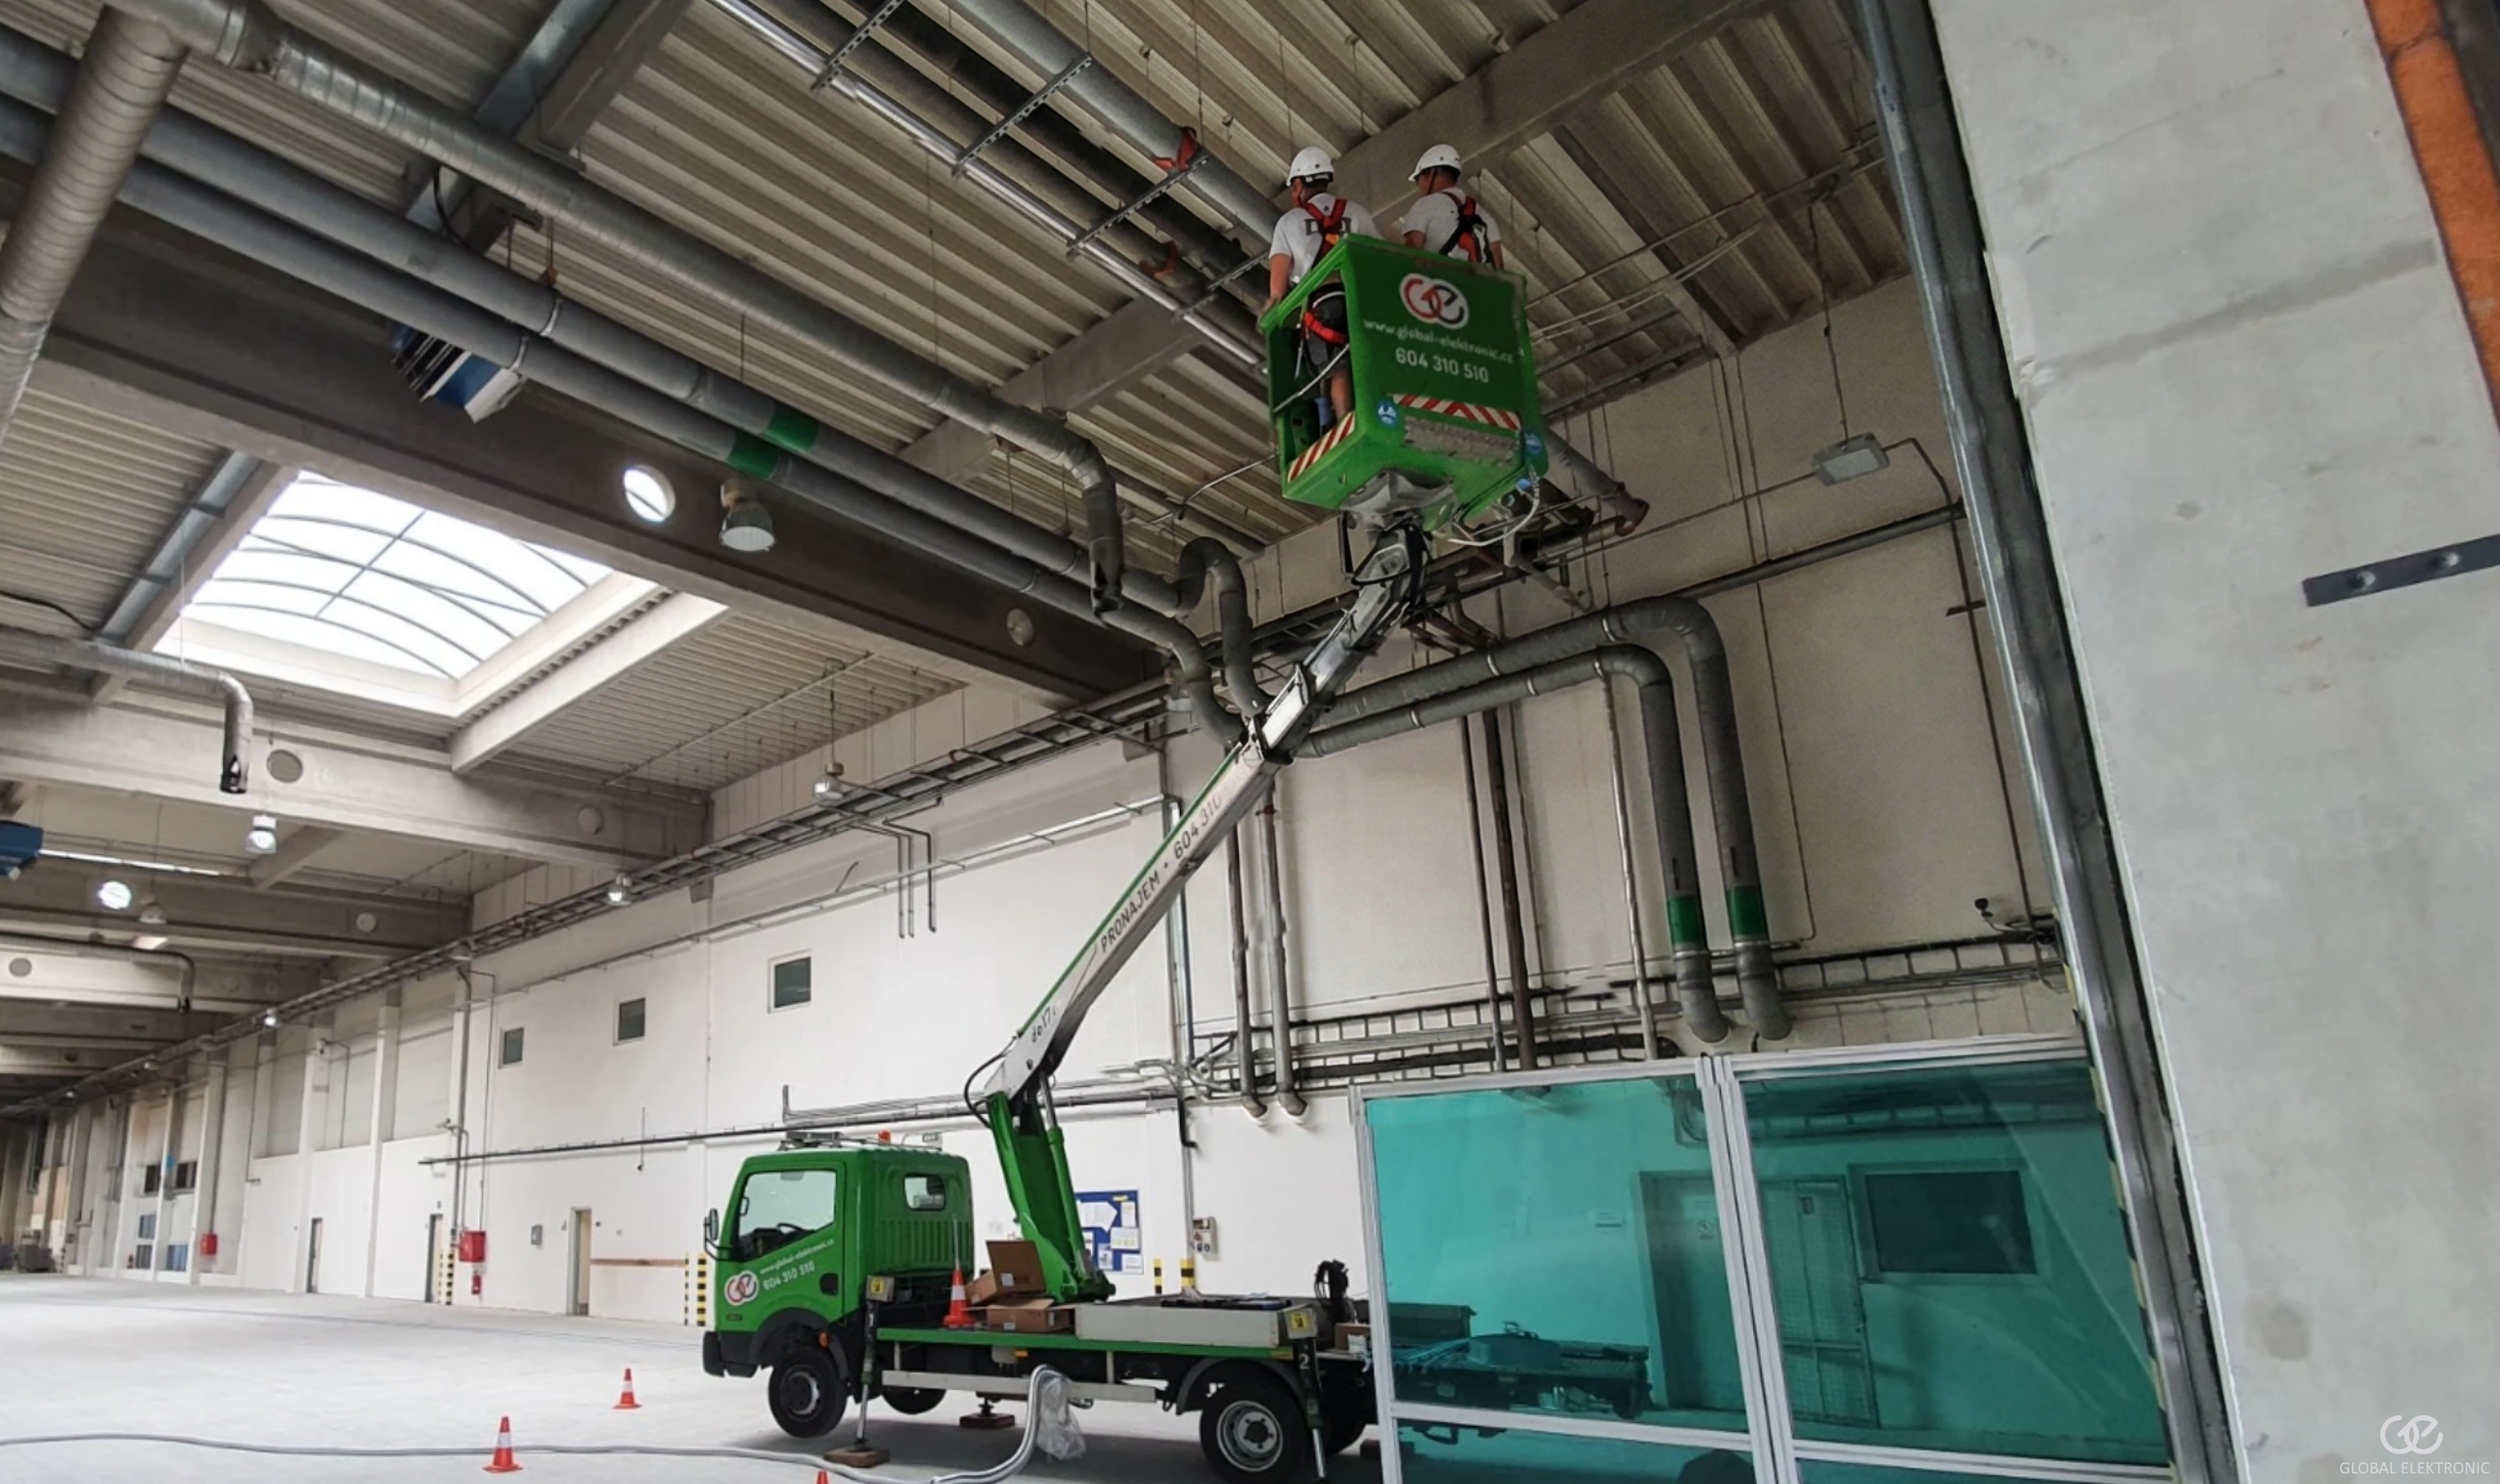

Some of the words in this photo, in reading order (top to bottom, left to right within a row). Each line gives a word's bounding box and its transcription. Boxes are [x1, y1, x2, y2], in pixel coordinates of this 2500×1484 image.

[1395, 347, 1428, 368] 604
[1432, 355, 1459, 376] 310
[1463, 362, 1490, 384] 510
[1173, 826, 1199, 860] 604
[1201, 794, 1222, 827] 310
[1298, 1353, 1310, 1370] 2
